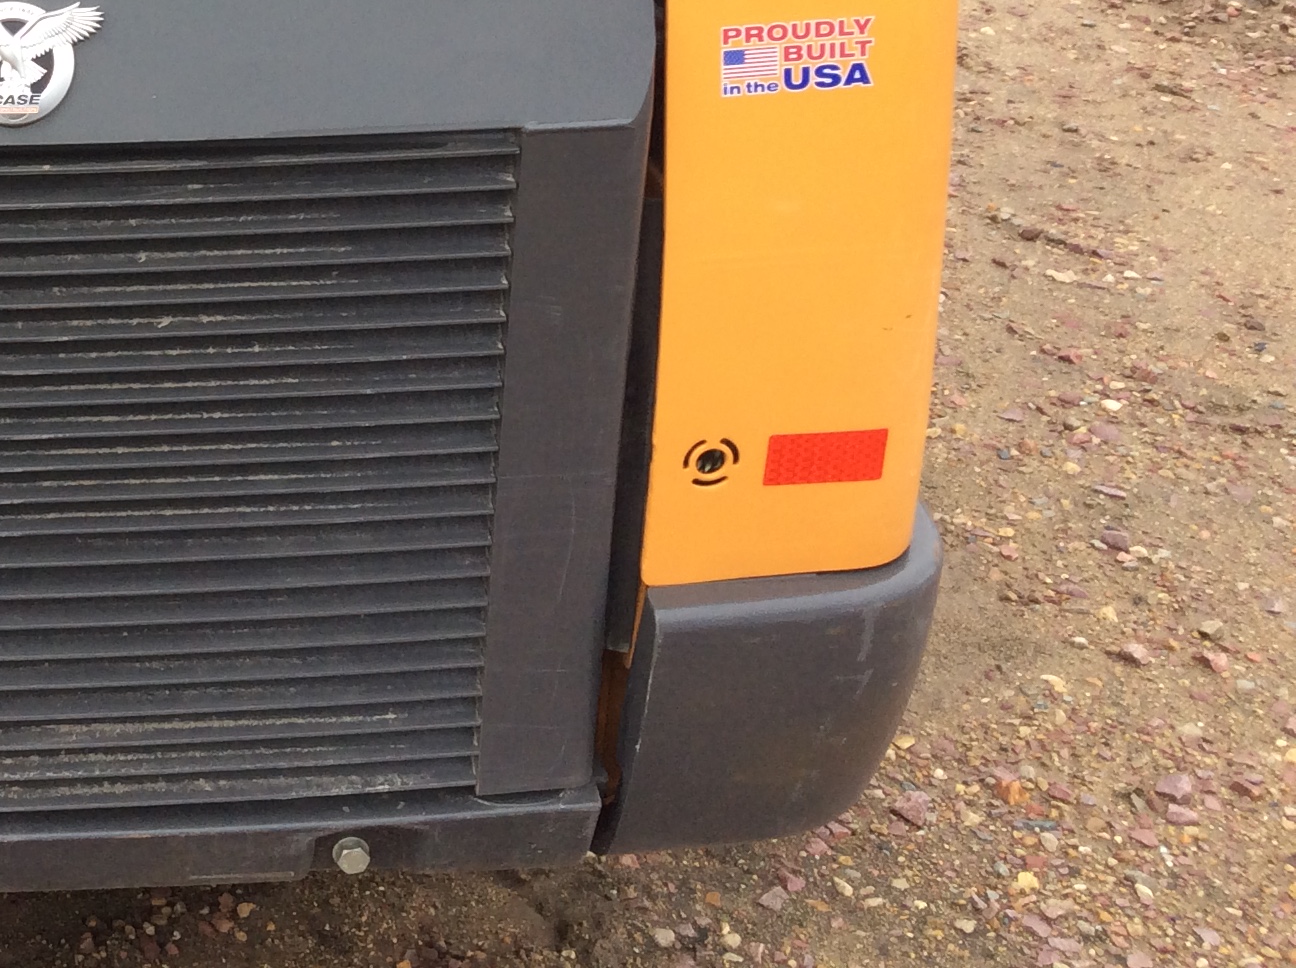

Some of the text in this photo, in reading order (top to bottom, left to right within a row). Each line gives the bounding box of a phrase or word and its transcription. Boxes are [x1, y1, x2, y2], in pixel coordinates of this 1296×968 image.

[722, 17, 873, 46] PROUDLY
[783, 39, 873, 62] BUILT
[722, 62, 872, 96] in the USA
